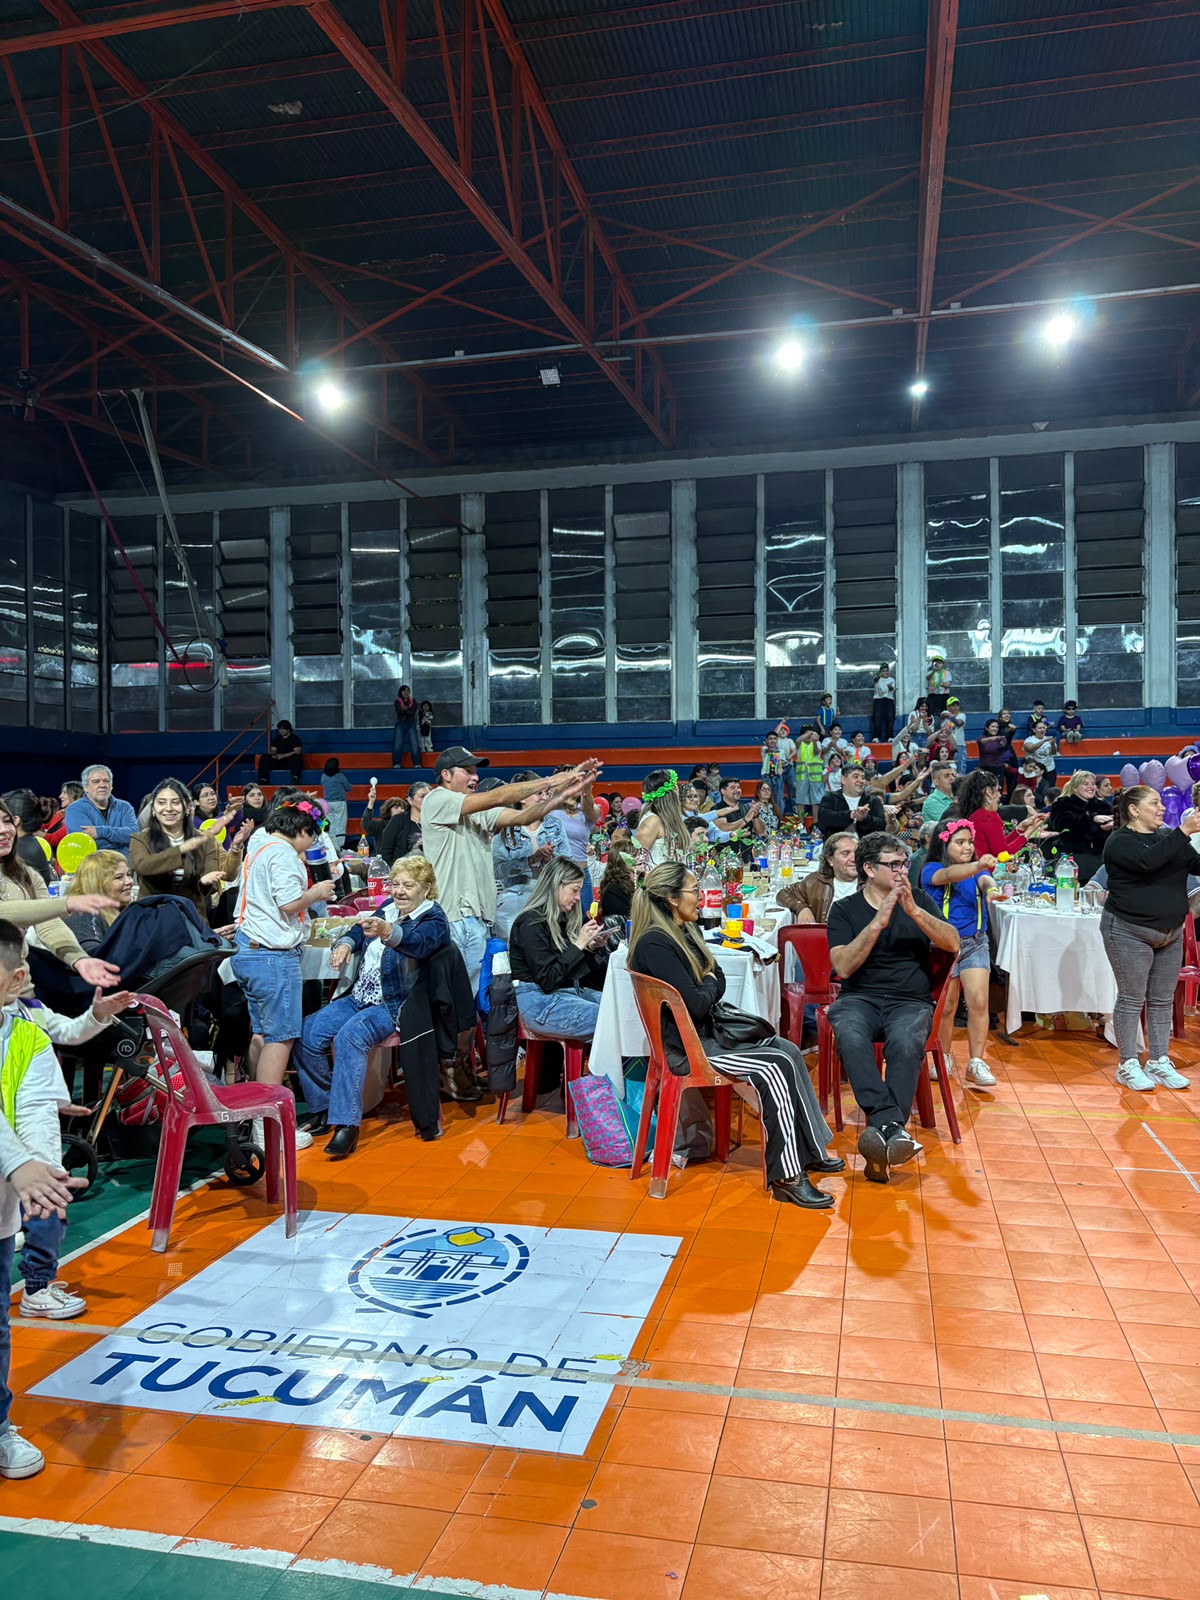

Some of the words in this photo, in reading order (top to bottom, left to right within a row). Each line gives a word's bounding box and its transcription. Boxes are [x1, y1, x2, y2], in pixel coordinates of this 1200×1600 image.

[136, 1322, 478, 1371] GOBIERNO
[498, 1352, 597, 1384] DE
[90, 1352, 579, 1432] TUCUMÁN
